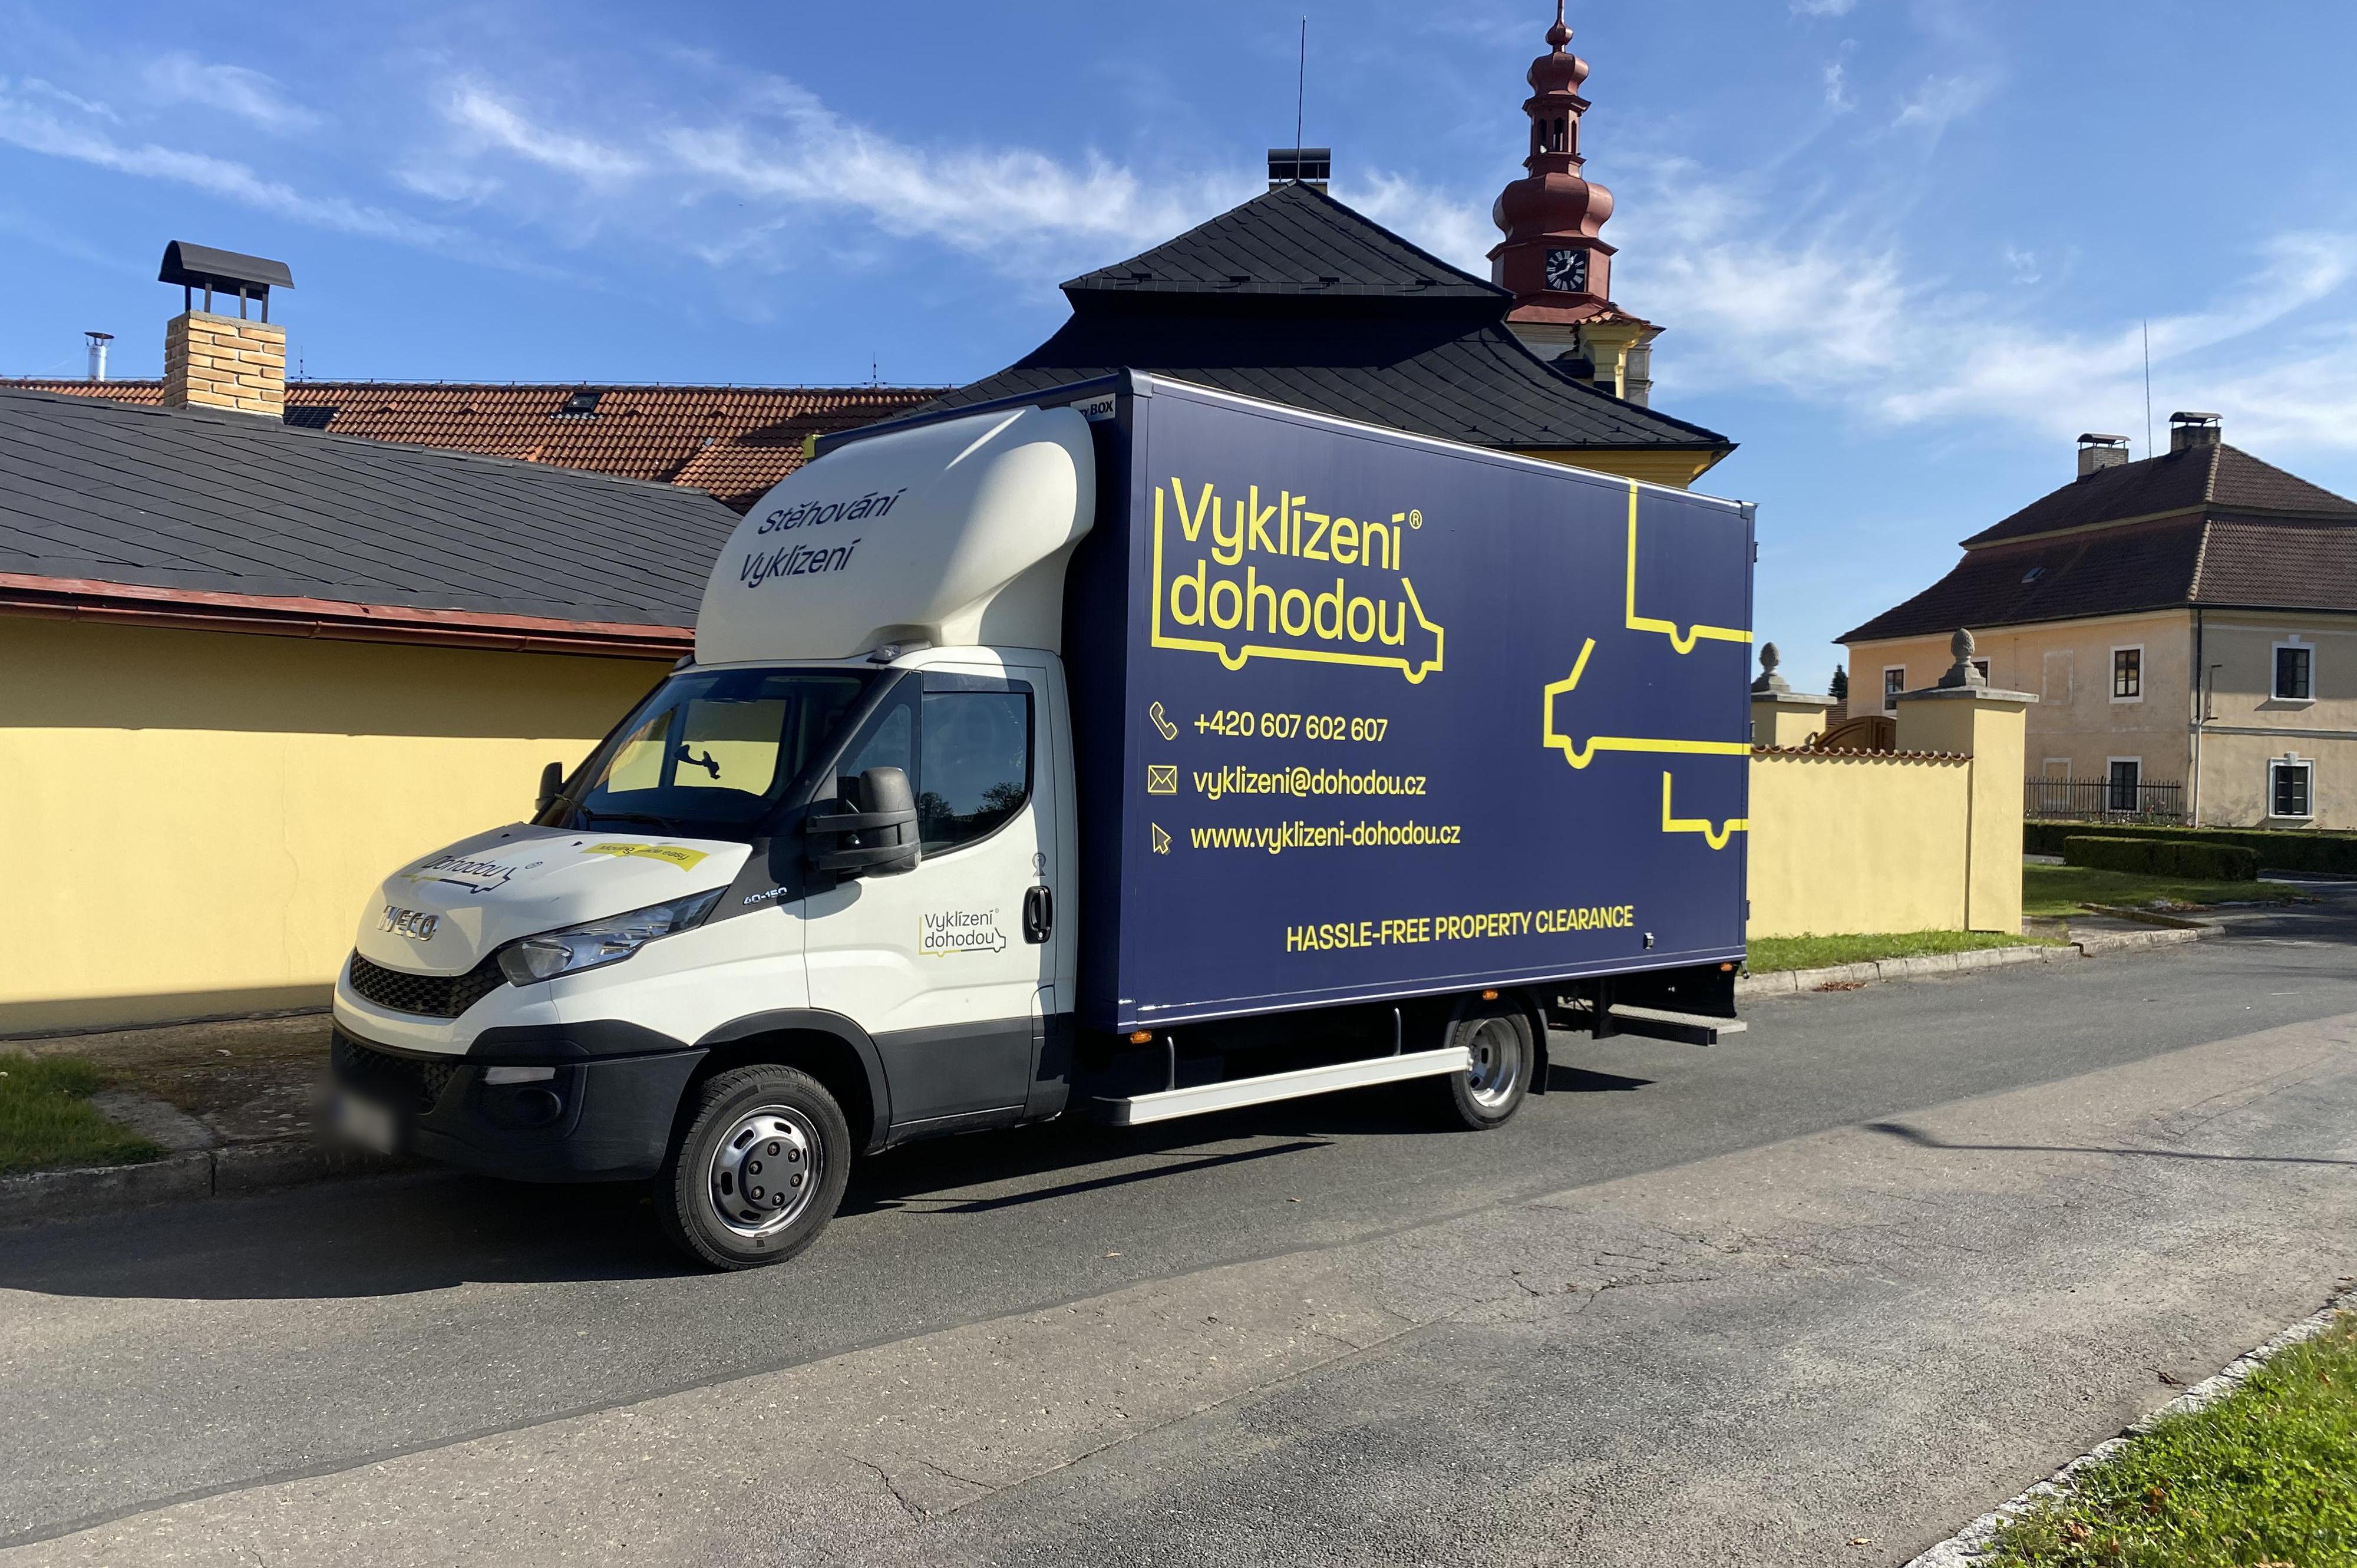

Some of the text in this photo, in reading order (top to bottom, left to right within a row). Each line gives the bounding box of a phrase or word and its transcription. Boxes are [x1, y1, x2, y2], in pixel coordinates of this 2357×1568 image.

[1090, 400, 1114, 415] BOX
[757, 487, 908, 535] Stěhování
[740, 538, 861, 589] Vyklízení
[1170, 559, 1406, 646] dohodou
[1194, 711, 1388, 742] +420 607 602 607
[1193, 766, 1427, 800] vyklizeni@dohodou.cz
[1190, 820, 1461, 854] www.vyklizeni-dohodou.cz
[743, 887, 788, 905] 40-150
[377, 905, 440, 942] IVECO
[925, 929, 995, 948] dohodou
[1286, 905, 1635, 952] HASSLE-FREE PROPERTY CLEARANCE
